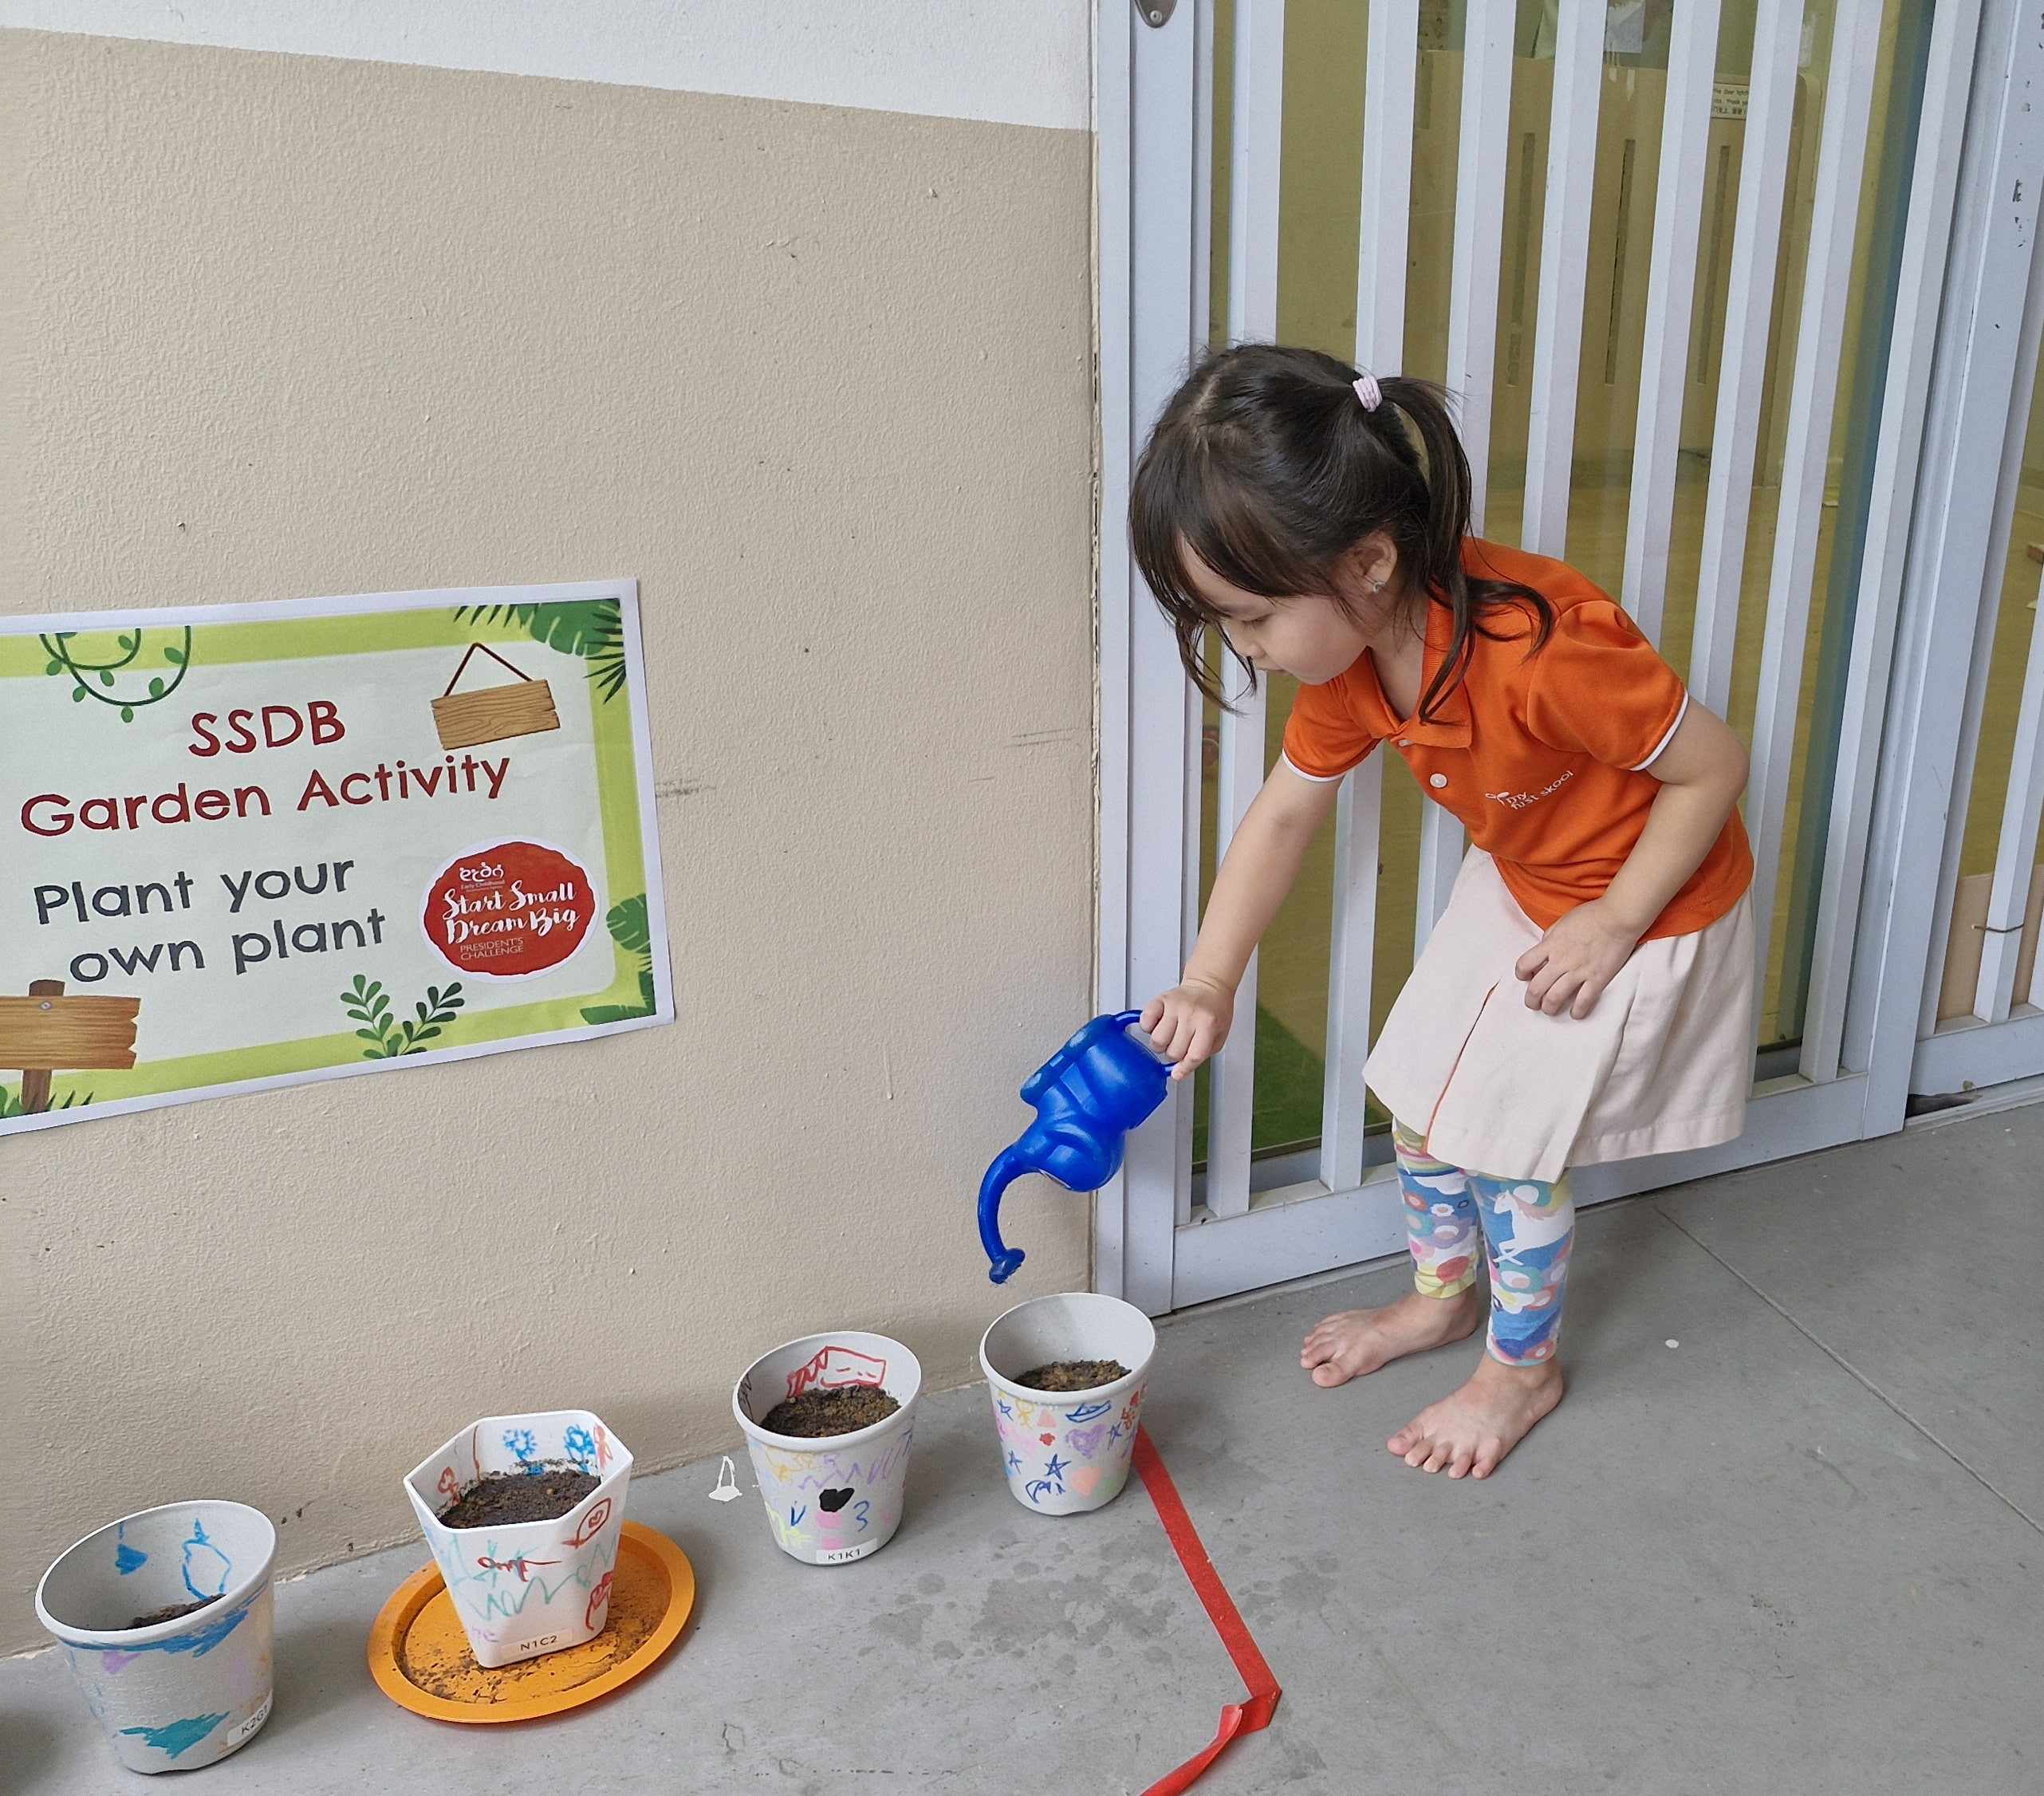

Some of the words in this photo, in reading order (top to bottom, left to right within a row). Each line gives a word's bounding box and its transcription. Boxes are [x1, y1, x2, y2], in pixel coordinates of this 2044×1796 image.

[188, 700, 345, 757] SSDB
[21, 782, 272, 837] Garden
[297, 754, 510, 811] Activity
[1540, 770, 1575, 797] skool
[33, 871, 194, 924] Plant
[220, 860, 354, 913] your
[442, 888, 506, 920] Start
[509, 880, 577, 911] Small
[445, 916, 528, 945] Dream
[528, 908, 581, 937] Big
[459, 936, 524, 952] PRESIDENT'S
[69, 939, 206, 983] own
[232, 908, 386, 975] plant
[460, 944, 524, 961] CHALLENGE
[828, 1549, 862, 1562] K1K1
[520, 1635, 558, 1652] N1C2
